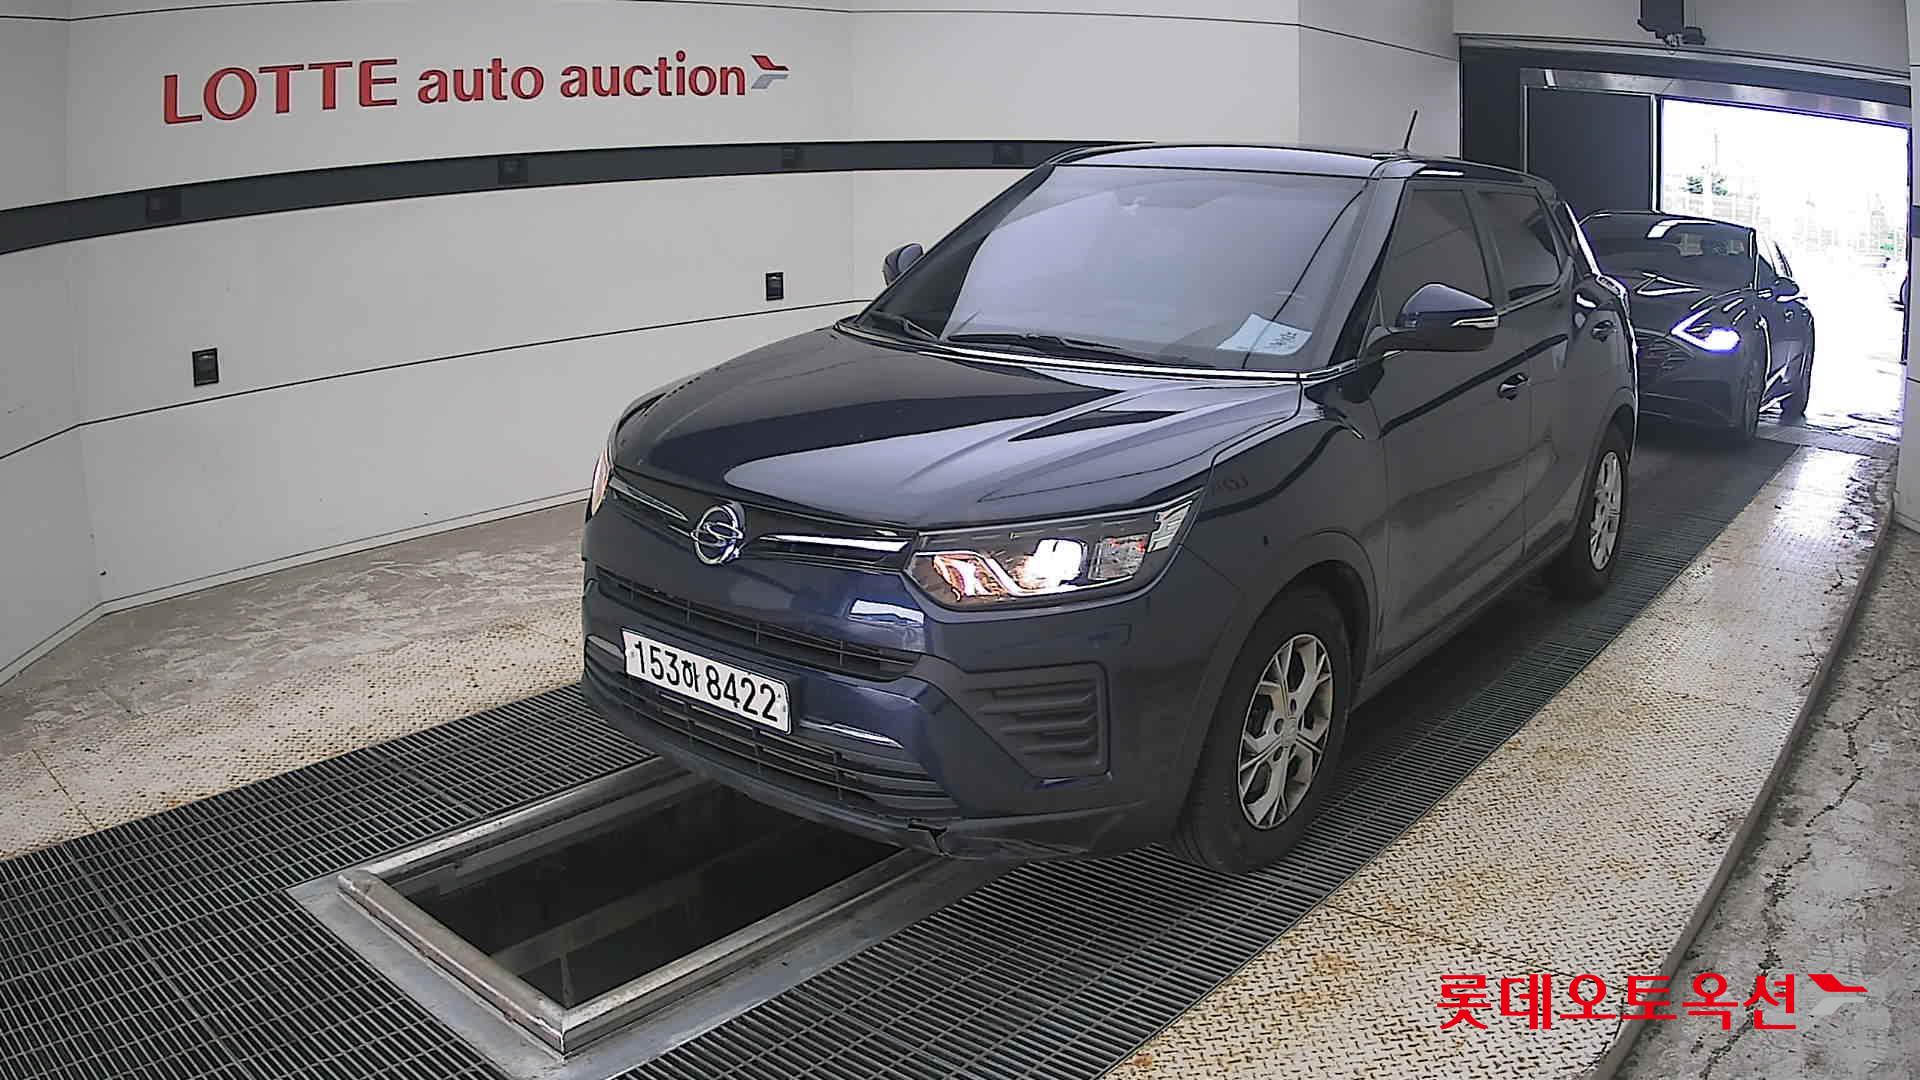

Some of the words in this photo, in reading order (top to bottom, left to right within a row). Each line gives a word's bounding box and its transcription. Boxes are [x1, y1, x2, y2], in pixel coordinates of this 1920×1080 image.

[163, 59, 398, 124] LOTTE
[416, 56, 544, 103] auto
[559, 50, 746, 97] auction
